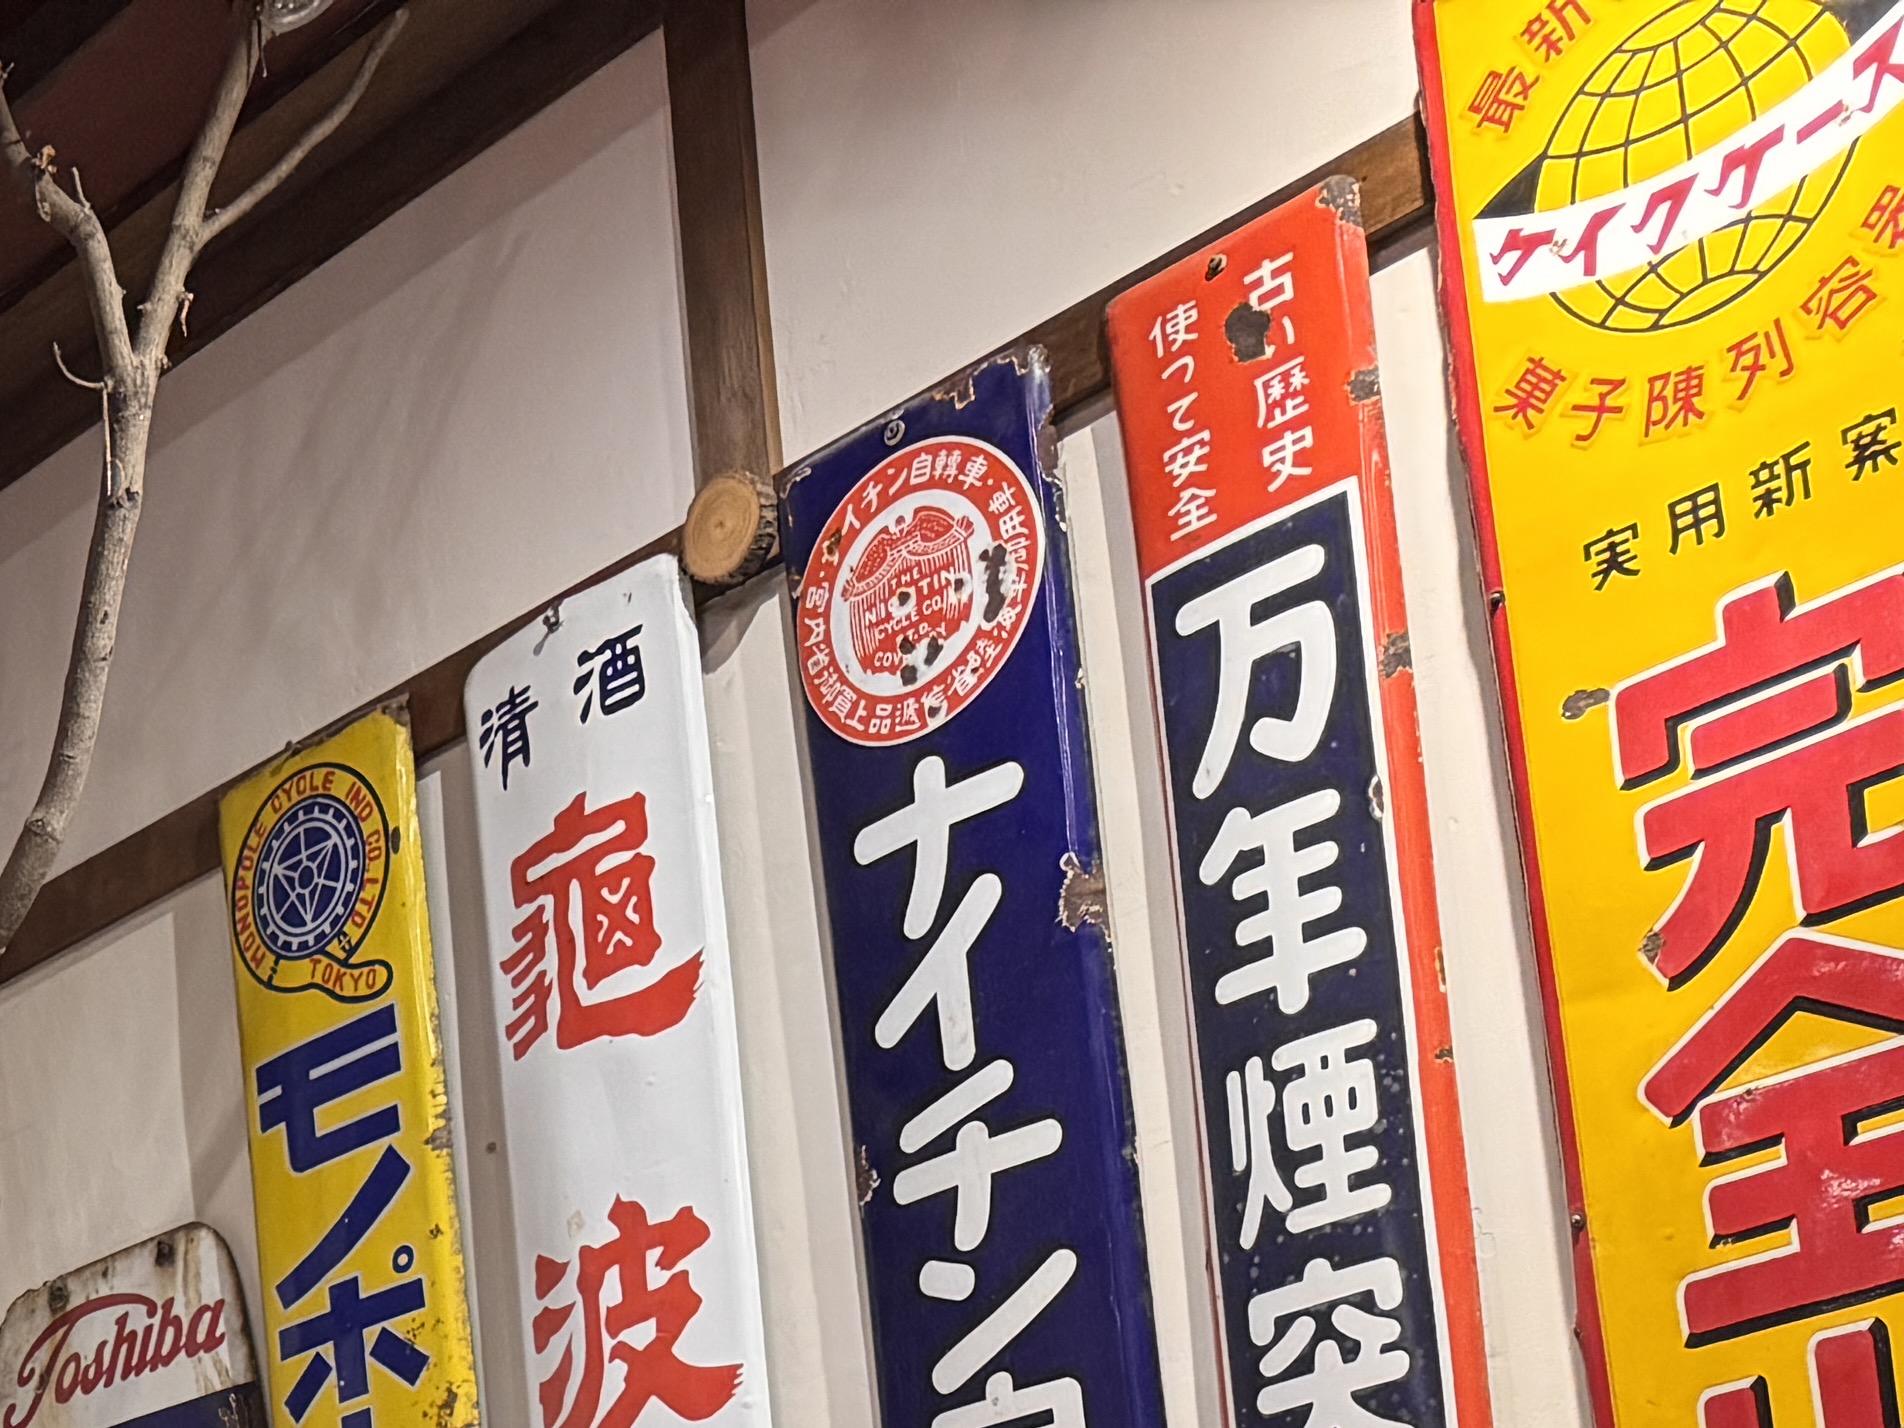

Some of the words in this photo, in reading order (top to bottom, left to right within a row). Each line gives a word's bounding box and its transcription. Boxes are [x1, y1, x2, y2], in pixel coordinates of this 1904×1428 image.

[1147, 297, 1218, 543] 使って安全
[1581, 405, 1900, 592] 実用新案
[890, 566, 920, 590] THE
[876, 605, 921, 640] CYCLE
[479, 623, 647, 791] 清酒
[345, 781, 375, 823] IND
[309, 957, 378, 993] TOKYO
